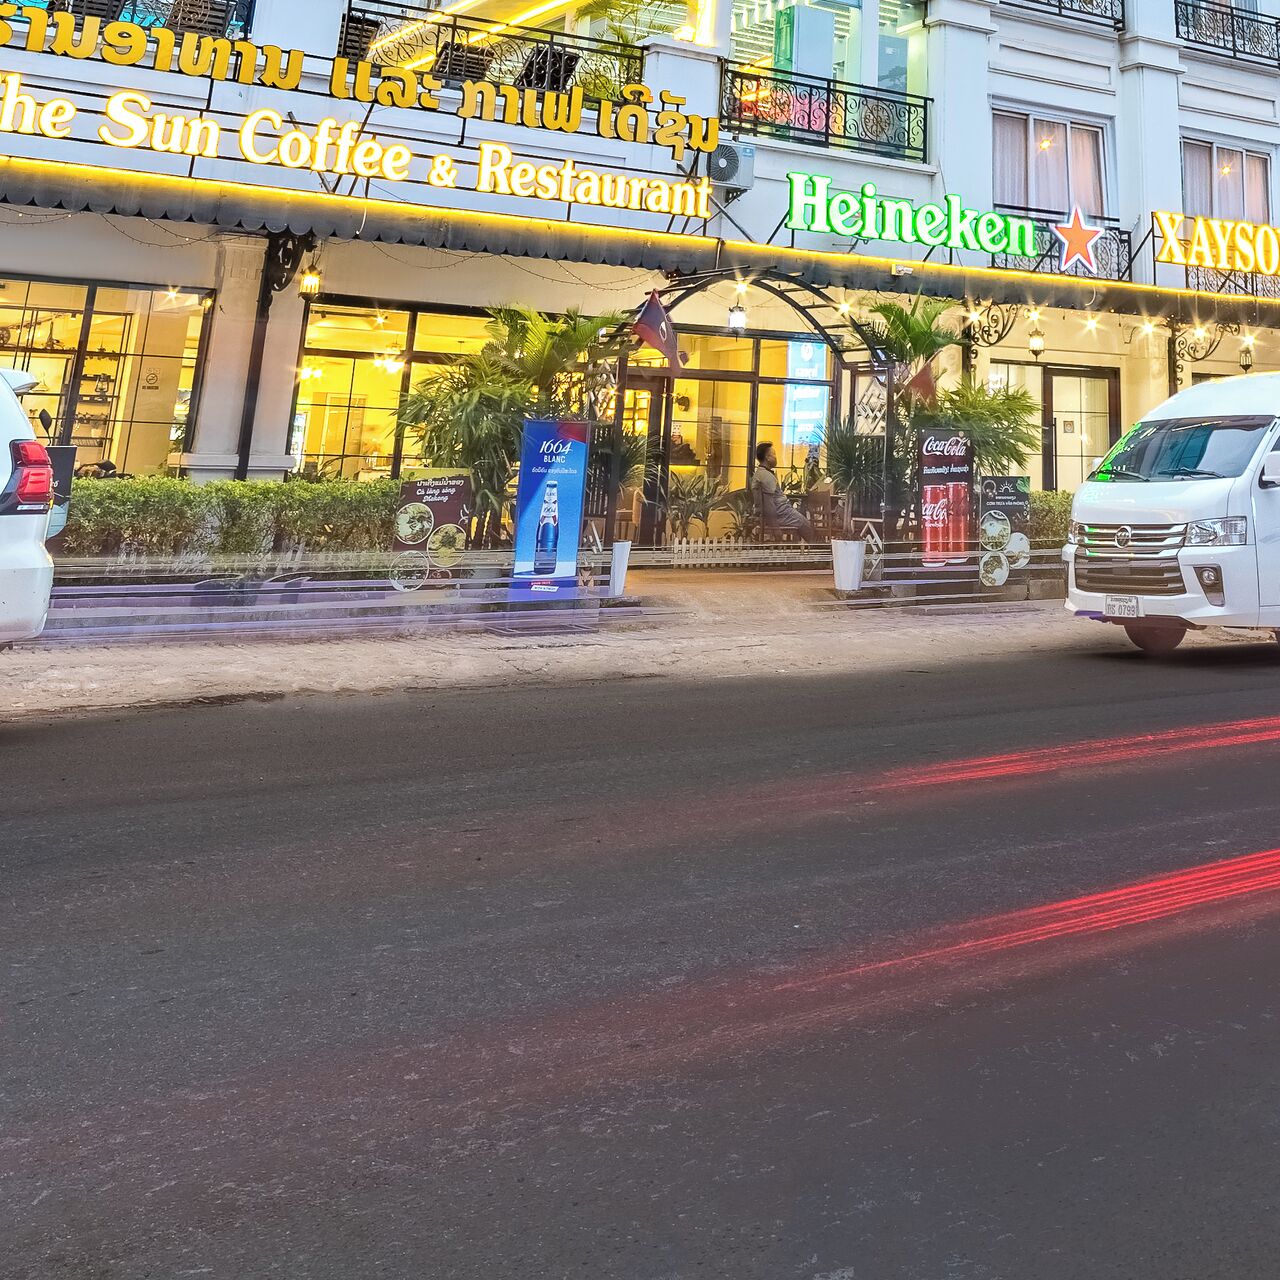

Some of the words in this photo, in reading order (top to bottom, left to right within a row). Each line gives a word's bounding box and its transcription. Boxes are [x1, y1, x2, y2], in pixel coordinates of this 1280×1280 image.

[330, 57, 442, 109] ແລະ
[98, 90, 222, 158] Sun
[239, 107, 411, 181] Coffee
[428, 153, 458, 188] &
[476, 140, 714, 219] Restaurant
[785, 171, 1039, 258] Heineken
[539, 439, 573, 455] 1664
[543, 454, 566, 463] BLANC
[922, 435, 968, 456] Coca-Cola
